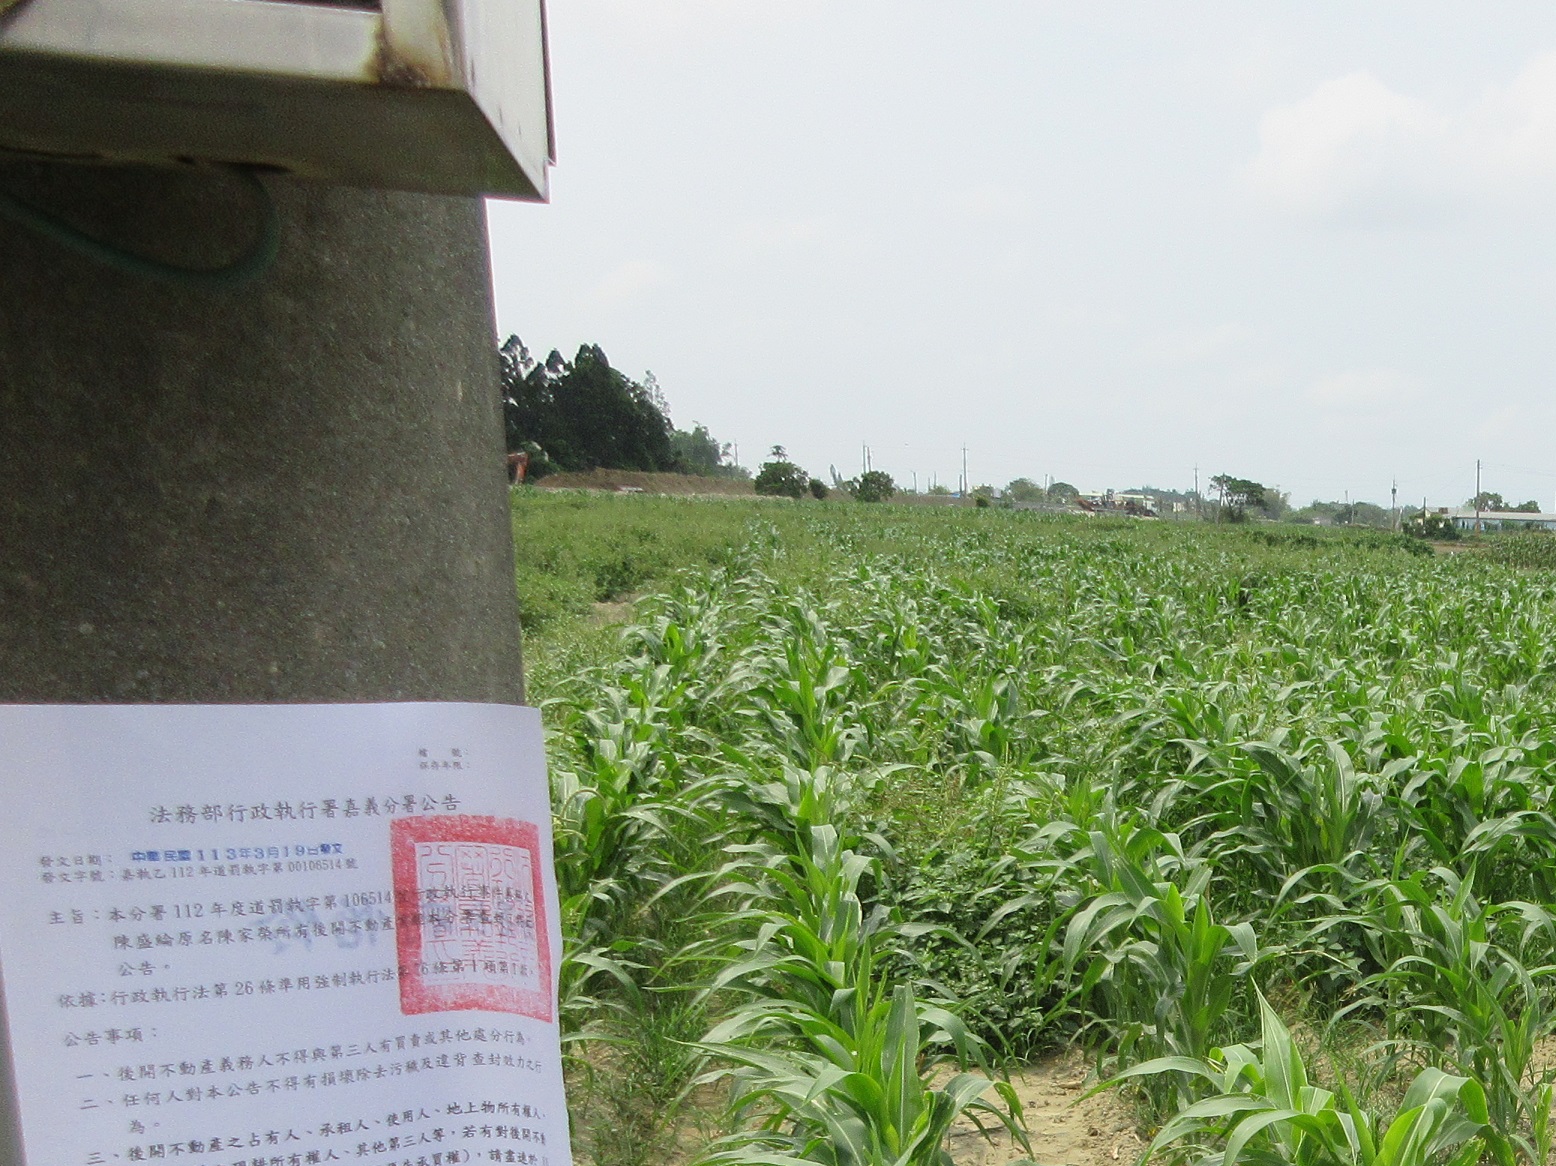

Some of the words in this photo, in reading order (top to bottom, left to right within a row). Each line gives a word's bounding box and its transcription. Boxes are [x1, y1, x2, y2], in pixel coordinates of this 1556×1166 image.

[149, 793, 461, 825] 法務部行政執行署嘉義分署公告
[117, 960, 170, 977] 公告。
[64, 1027, 157, 1047] 公告事項：
